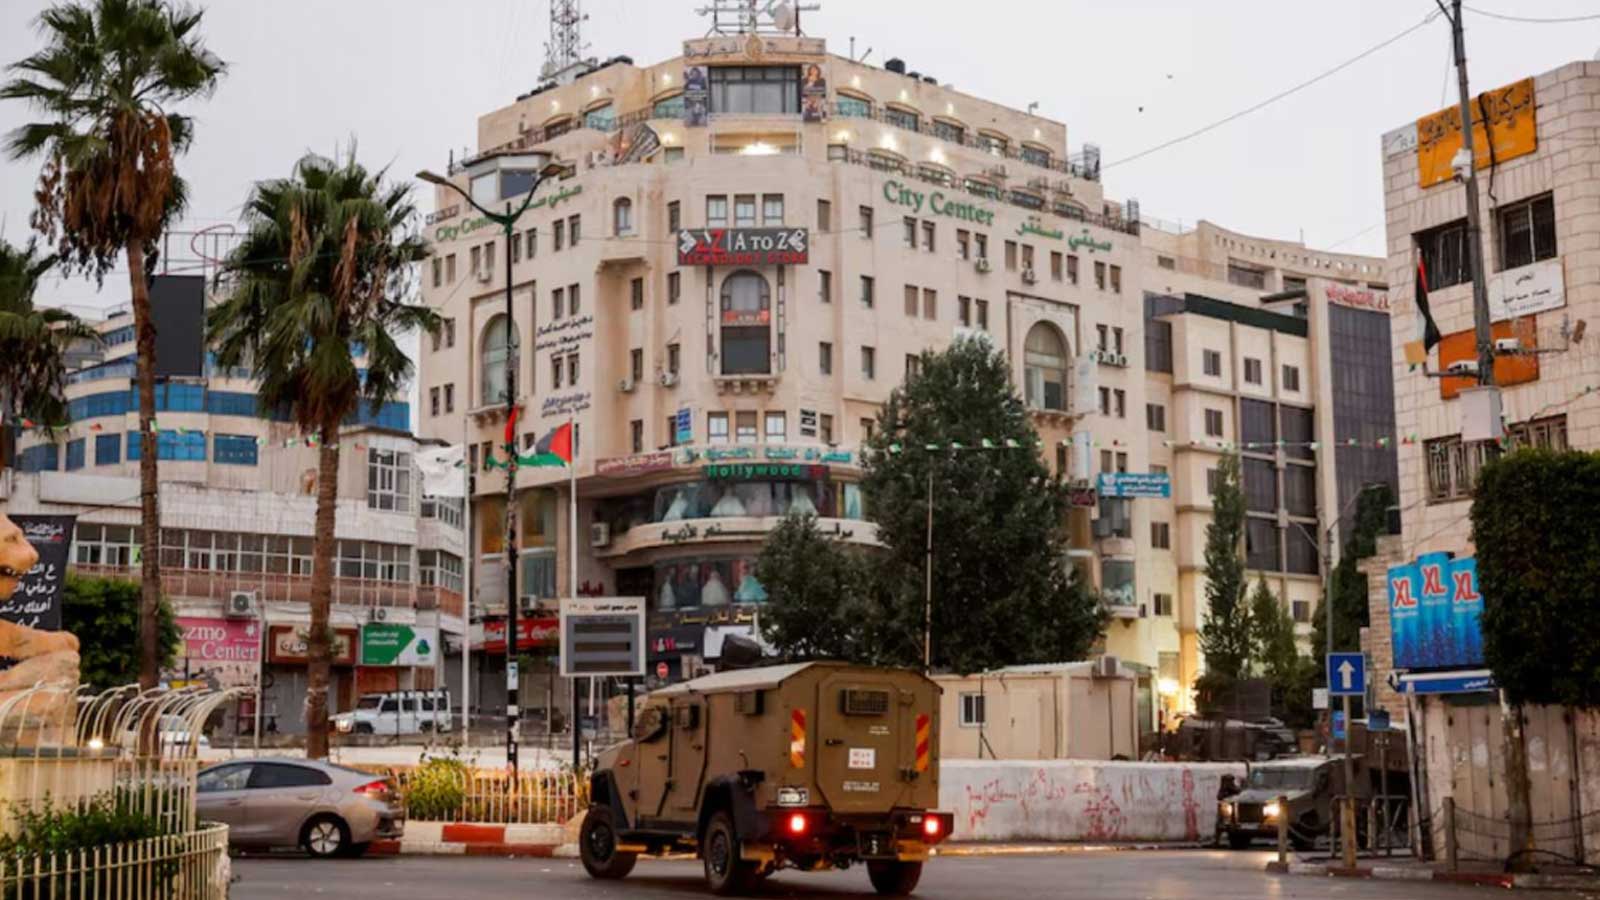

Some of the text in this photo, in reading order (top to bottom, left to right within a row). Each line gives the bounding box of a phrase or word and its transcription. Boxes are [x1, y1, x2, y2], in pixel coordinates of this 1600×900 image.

[883, 179, 995, 227] City Center
[436, 226, 459, 242] City
[735, 232, 747, 251] A
[777, 231, 789, 250] Z
[707, 464, 801, 478] Hollywood
[1421, 565, 1447, 596] XL
[1453, 571, 1480, 603] XL
[1391, 578, 1418, 608] XL
[177, 626, 226, 641] zmo
[201, 641, 256, 659] Center
